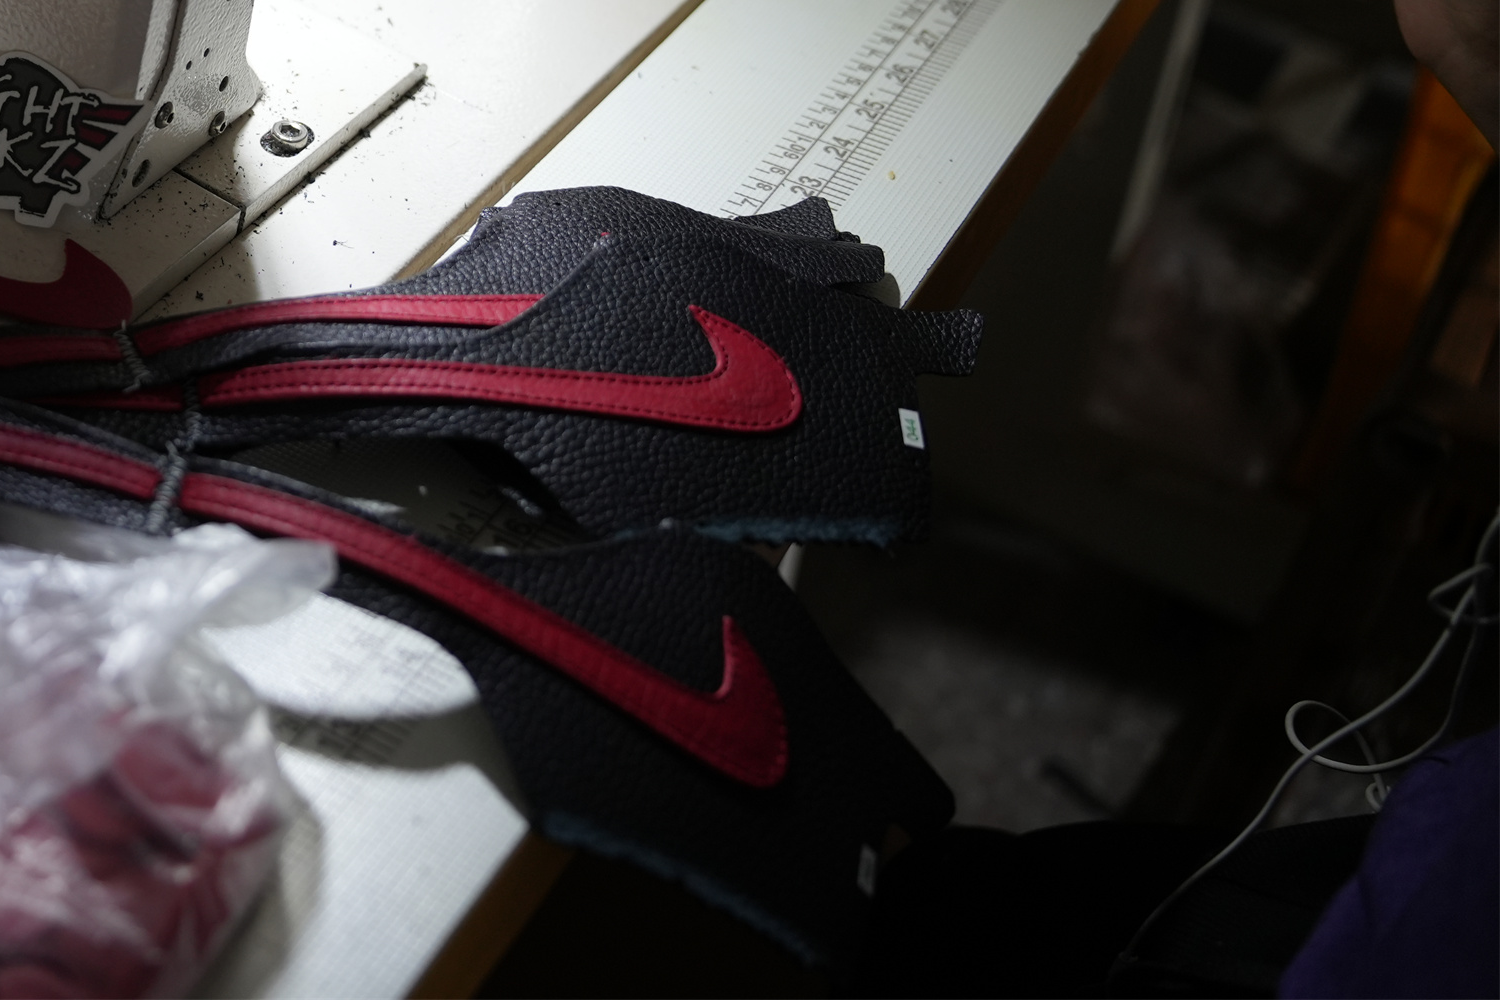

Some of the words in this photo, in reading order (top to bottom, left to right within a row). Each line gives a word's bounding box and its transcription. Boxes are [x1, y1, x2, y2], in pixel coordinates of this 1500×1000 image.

[740, 197, 758, 208] 7
[755, 182, 773, 192] 8
[769, 166, 786, 176] 9
[783, 143, 806, 160] 60
[808, 120, 826, 130] 2
[821, 106, 838, 115] 3
[790, 175, 822, 197] 23
[823, 136, 854, 159] 24
[855, 99, 885, 120] 25
[885, 63, 914, 84] 26
[914, 29, 940, 49] 27
